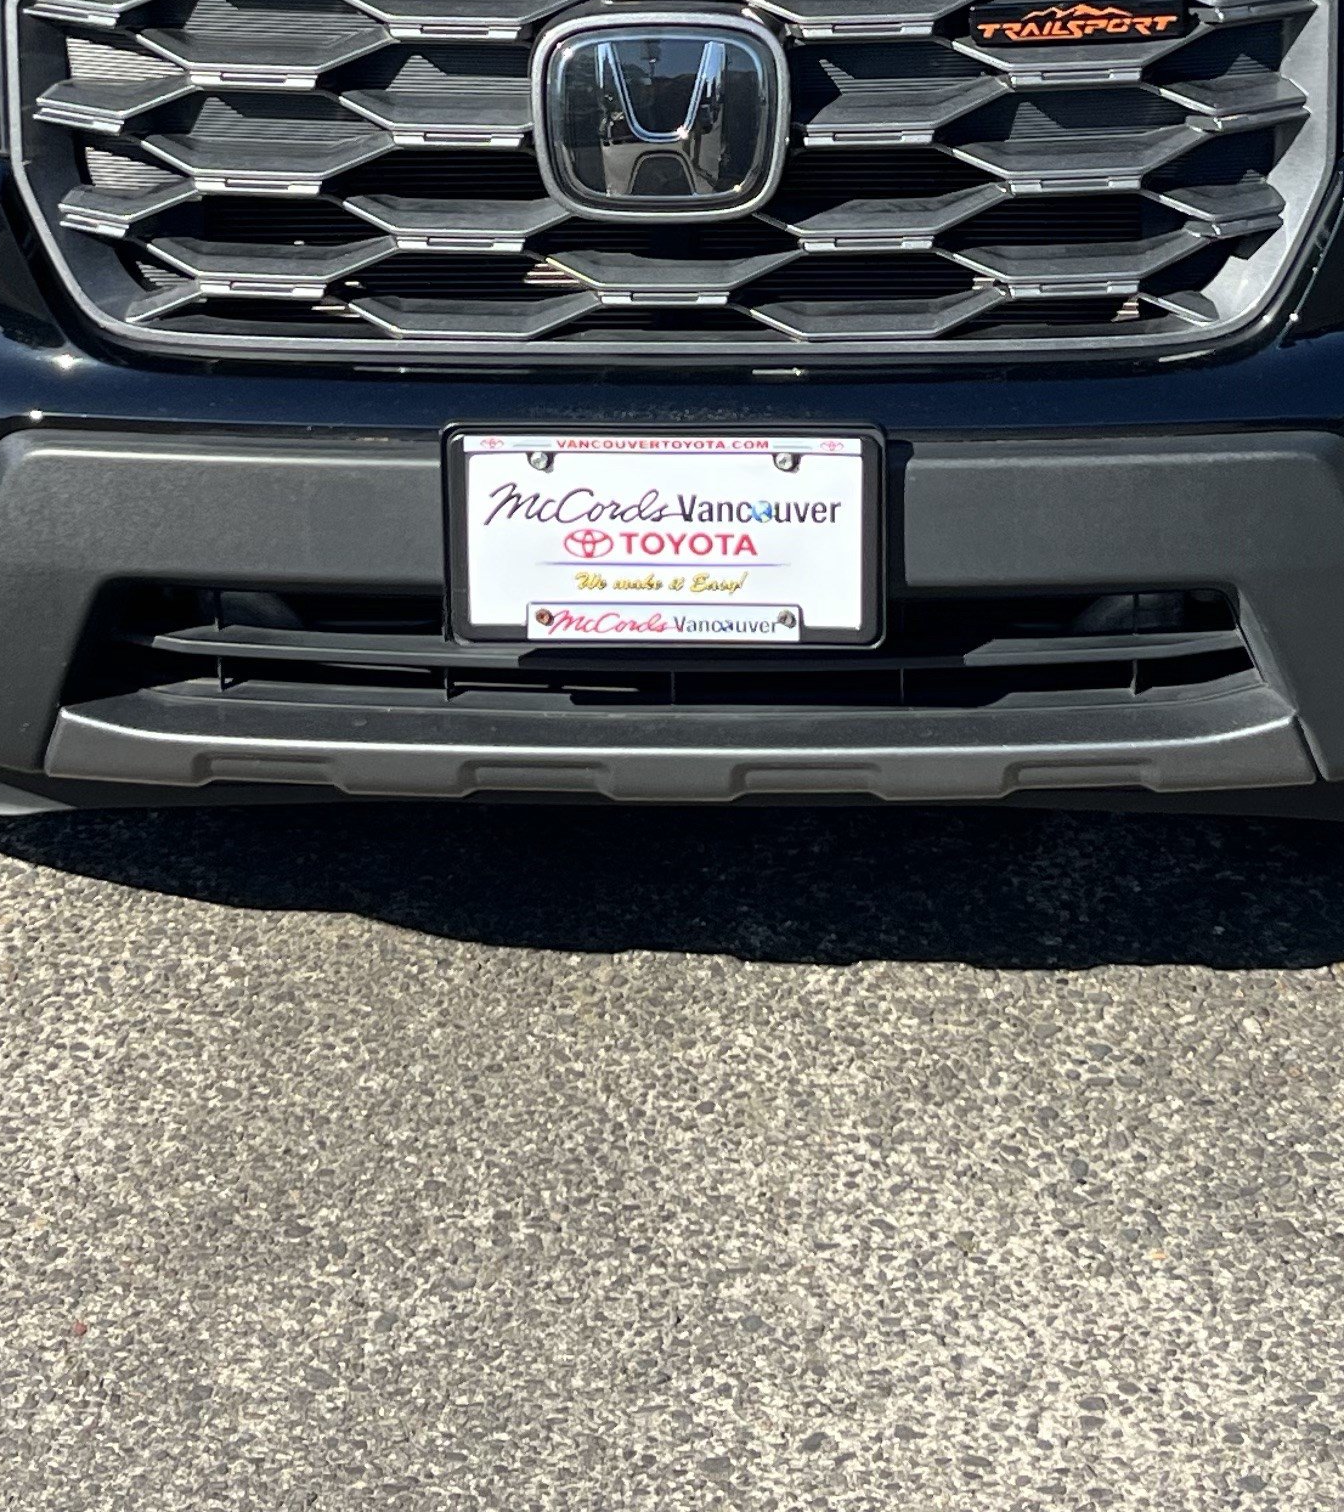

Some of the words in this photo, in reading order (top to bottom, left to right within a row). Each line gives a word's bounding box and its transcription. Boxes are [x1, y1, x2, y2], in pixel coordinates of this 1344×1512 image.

[976, 15, 1178, 41] TRAILSPORT
[556, 439, 770, 450] VANCOUVERTOYOTA.COM
[483, 482, 678, 526] McCords
[677, 494, 843, 524] Vancouver
[619, 532, 759, 556] TOYOTA
[574, 571, 608, 590] We
[612, 573, 664, 590] make
[689, 571, 751, 596] Easy!
[548, 609, 674, 636] McCords
[673, 615, 778, 634] Vancouver
